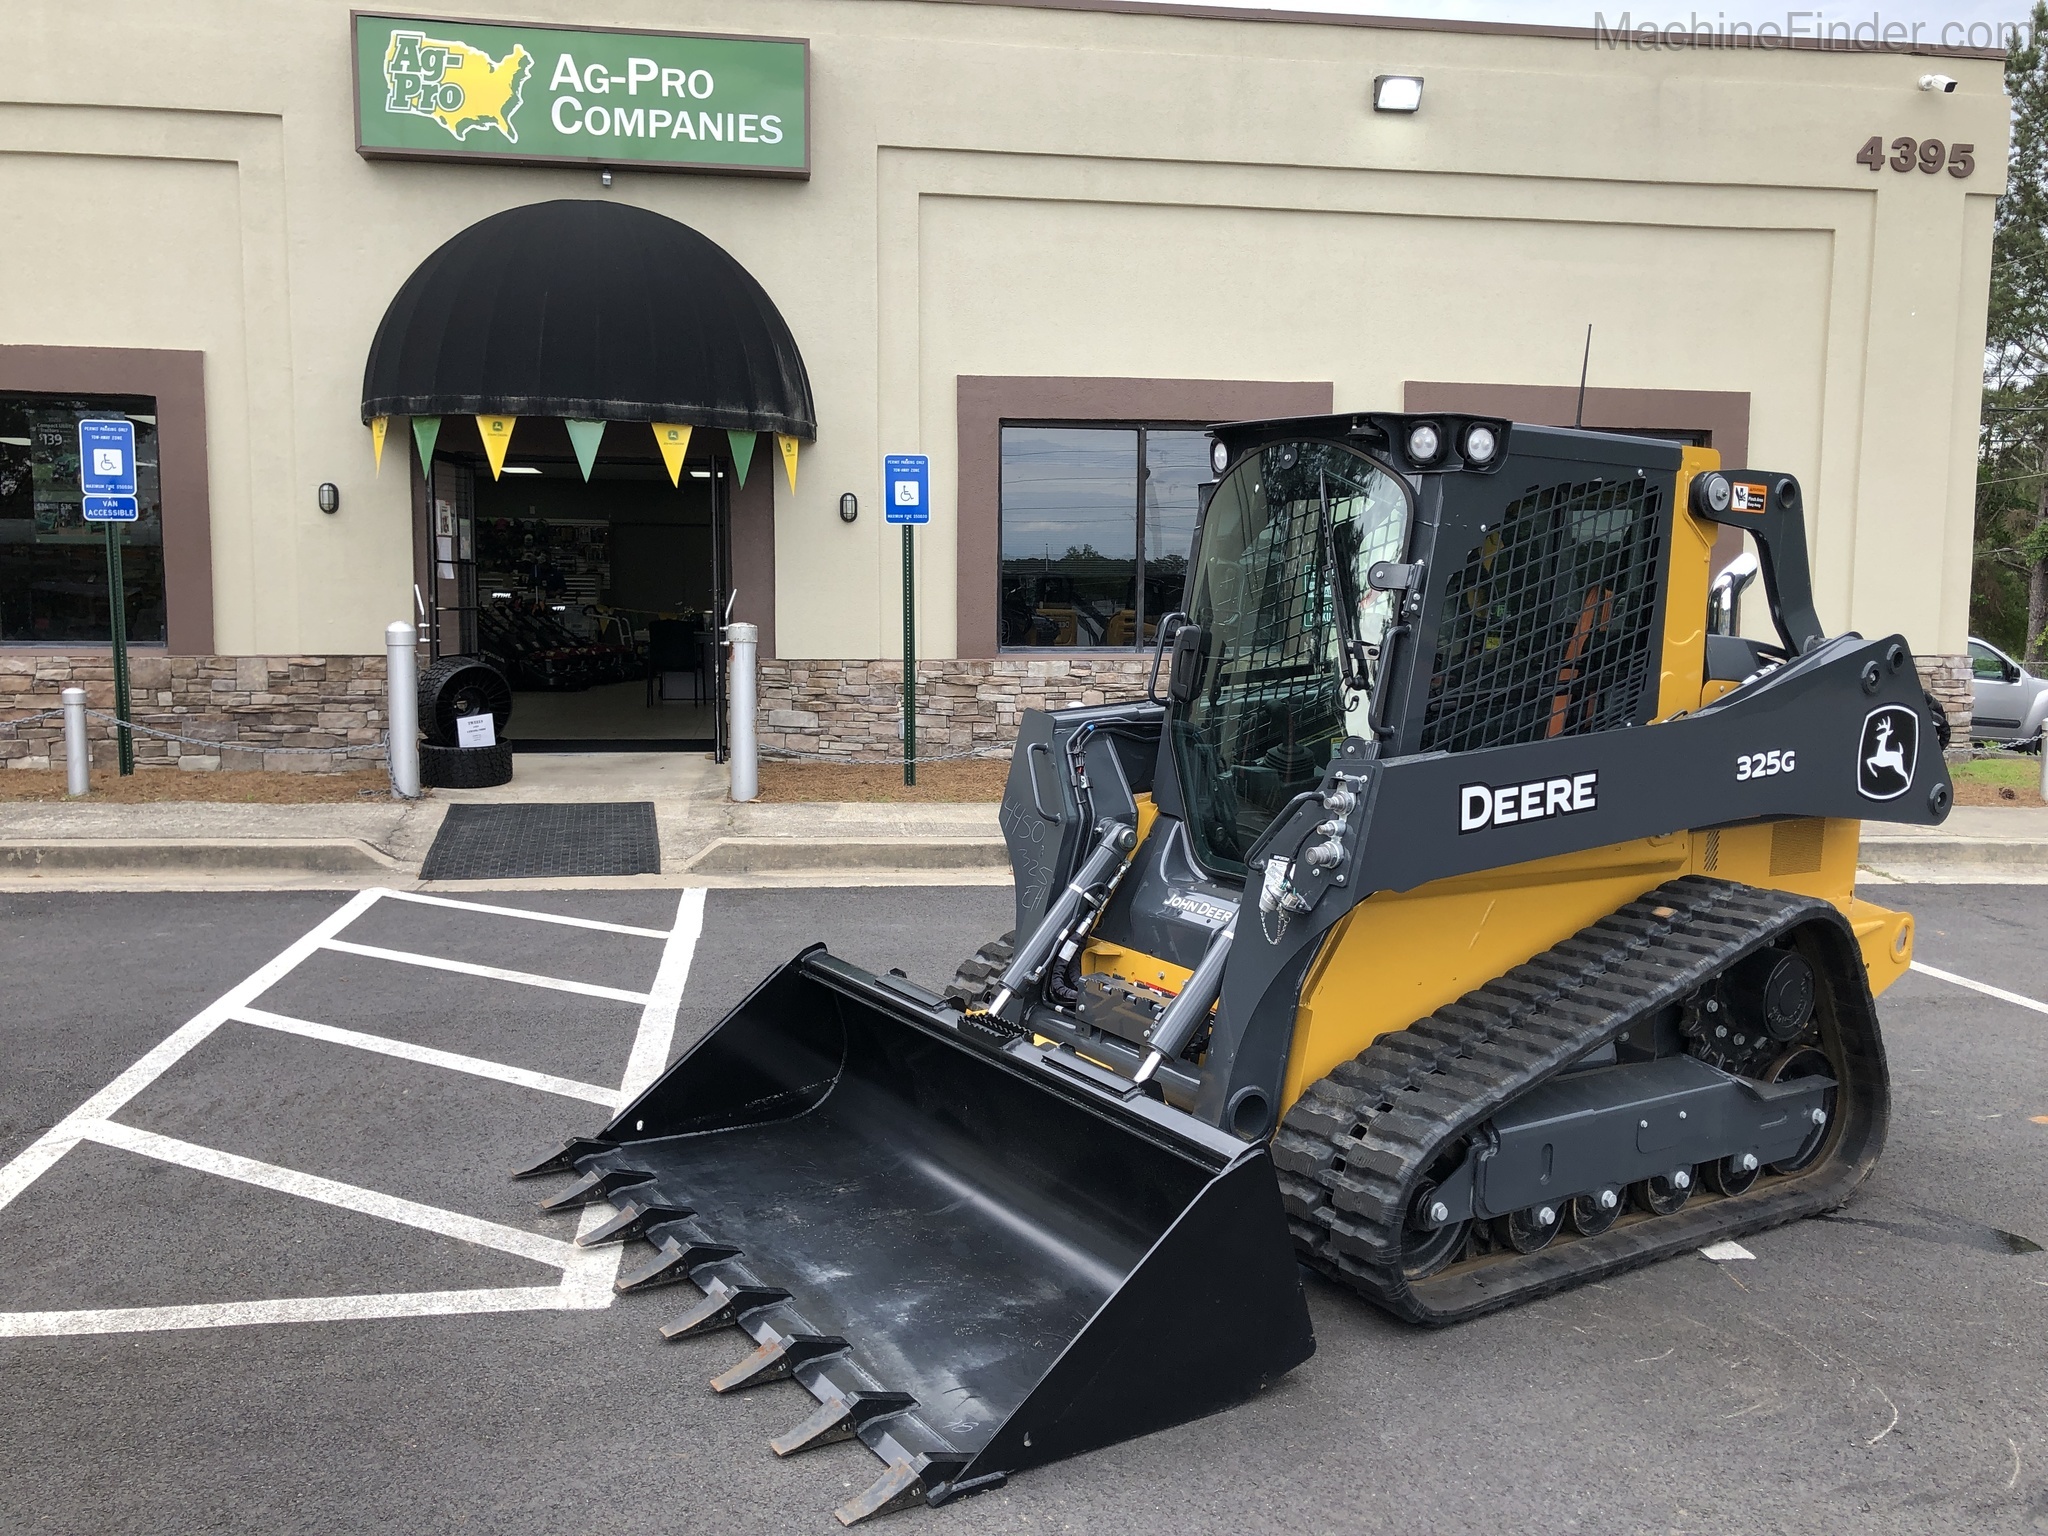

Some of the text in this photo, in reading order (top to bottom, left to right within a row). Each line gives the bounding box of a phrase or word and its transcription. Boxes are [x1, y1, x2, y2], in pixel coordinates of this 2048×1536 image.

[389, 31, 463, 81] Ag-
[386, 74, 464, 112] Pro
[551, 95, 784, 145] COMPANIES
[1856, 136, 1976, 179] 4395
[38, 433, 63, 446] $139
[88, 509, 135, 517] ACCESSIBLE
[1737, 749, 1796, 782] 325G
[1004, 796, 1046, 844] 4450
[1460, 772, 1597, 831] DEERE
[1018, 848, 1053, 886] 325
[1162, 893, 1233, 922] JOHN DEER
